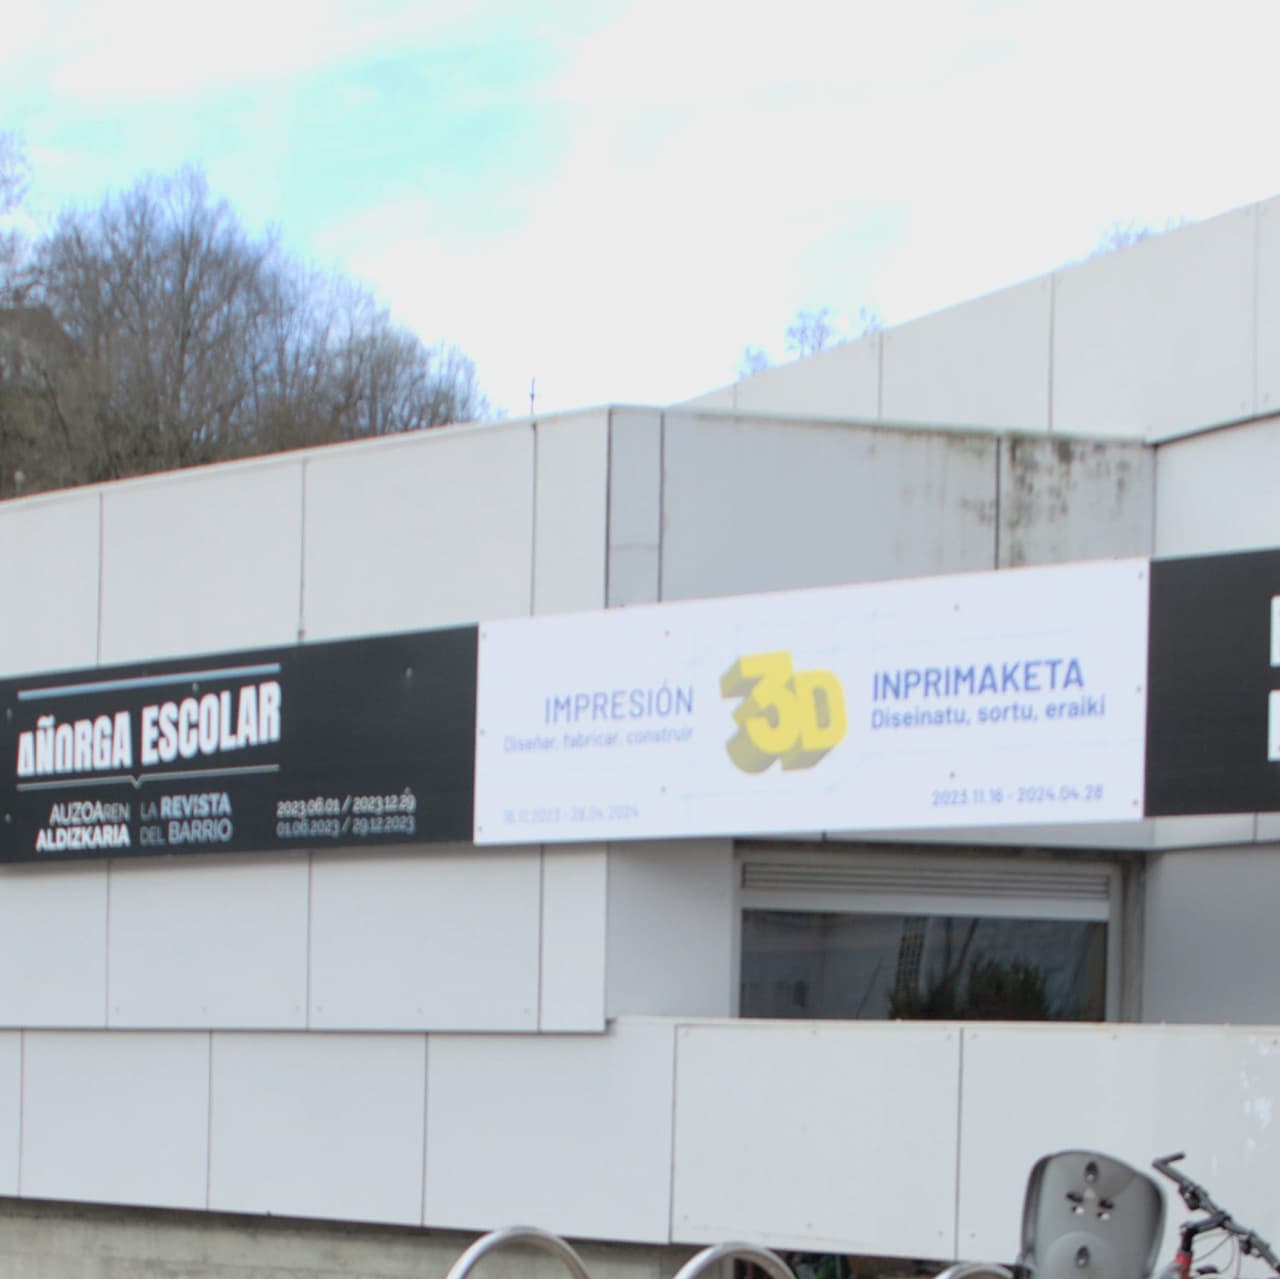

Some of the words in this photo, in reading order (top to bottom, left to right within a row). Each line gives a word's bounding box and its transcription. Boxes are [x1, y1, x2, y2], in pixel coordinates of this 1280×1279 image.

[872, 656, 1086, 702] INPRIMAKETA
[544, 678, 695, 724] IMPRESIÓN
[719, 650, 847, 774] 3D
[871, 704, 972, 731] Diseinatu,
[977, 700, 1039, 725] sortu,
[1045, 694, 1107, 719] eraiki
[16, 714, 132, 777] AÑORGA
[141, 681, 282, 767] ESCOLAR
[49, 800, 130, 826] AUZOAREN
[140, 801, 158, 818] LA
[160, 792, 232, 819] REVISTA
[35, 824, 131, 852] ALDIZKARIA
[140, 825, 166, 847] DEL
[168, 818, 234, 844] BARRIO
